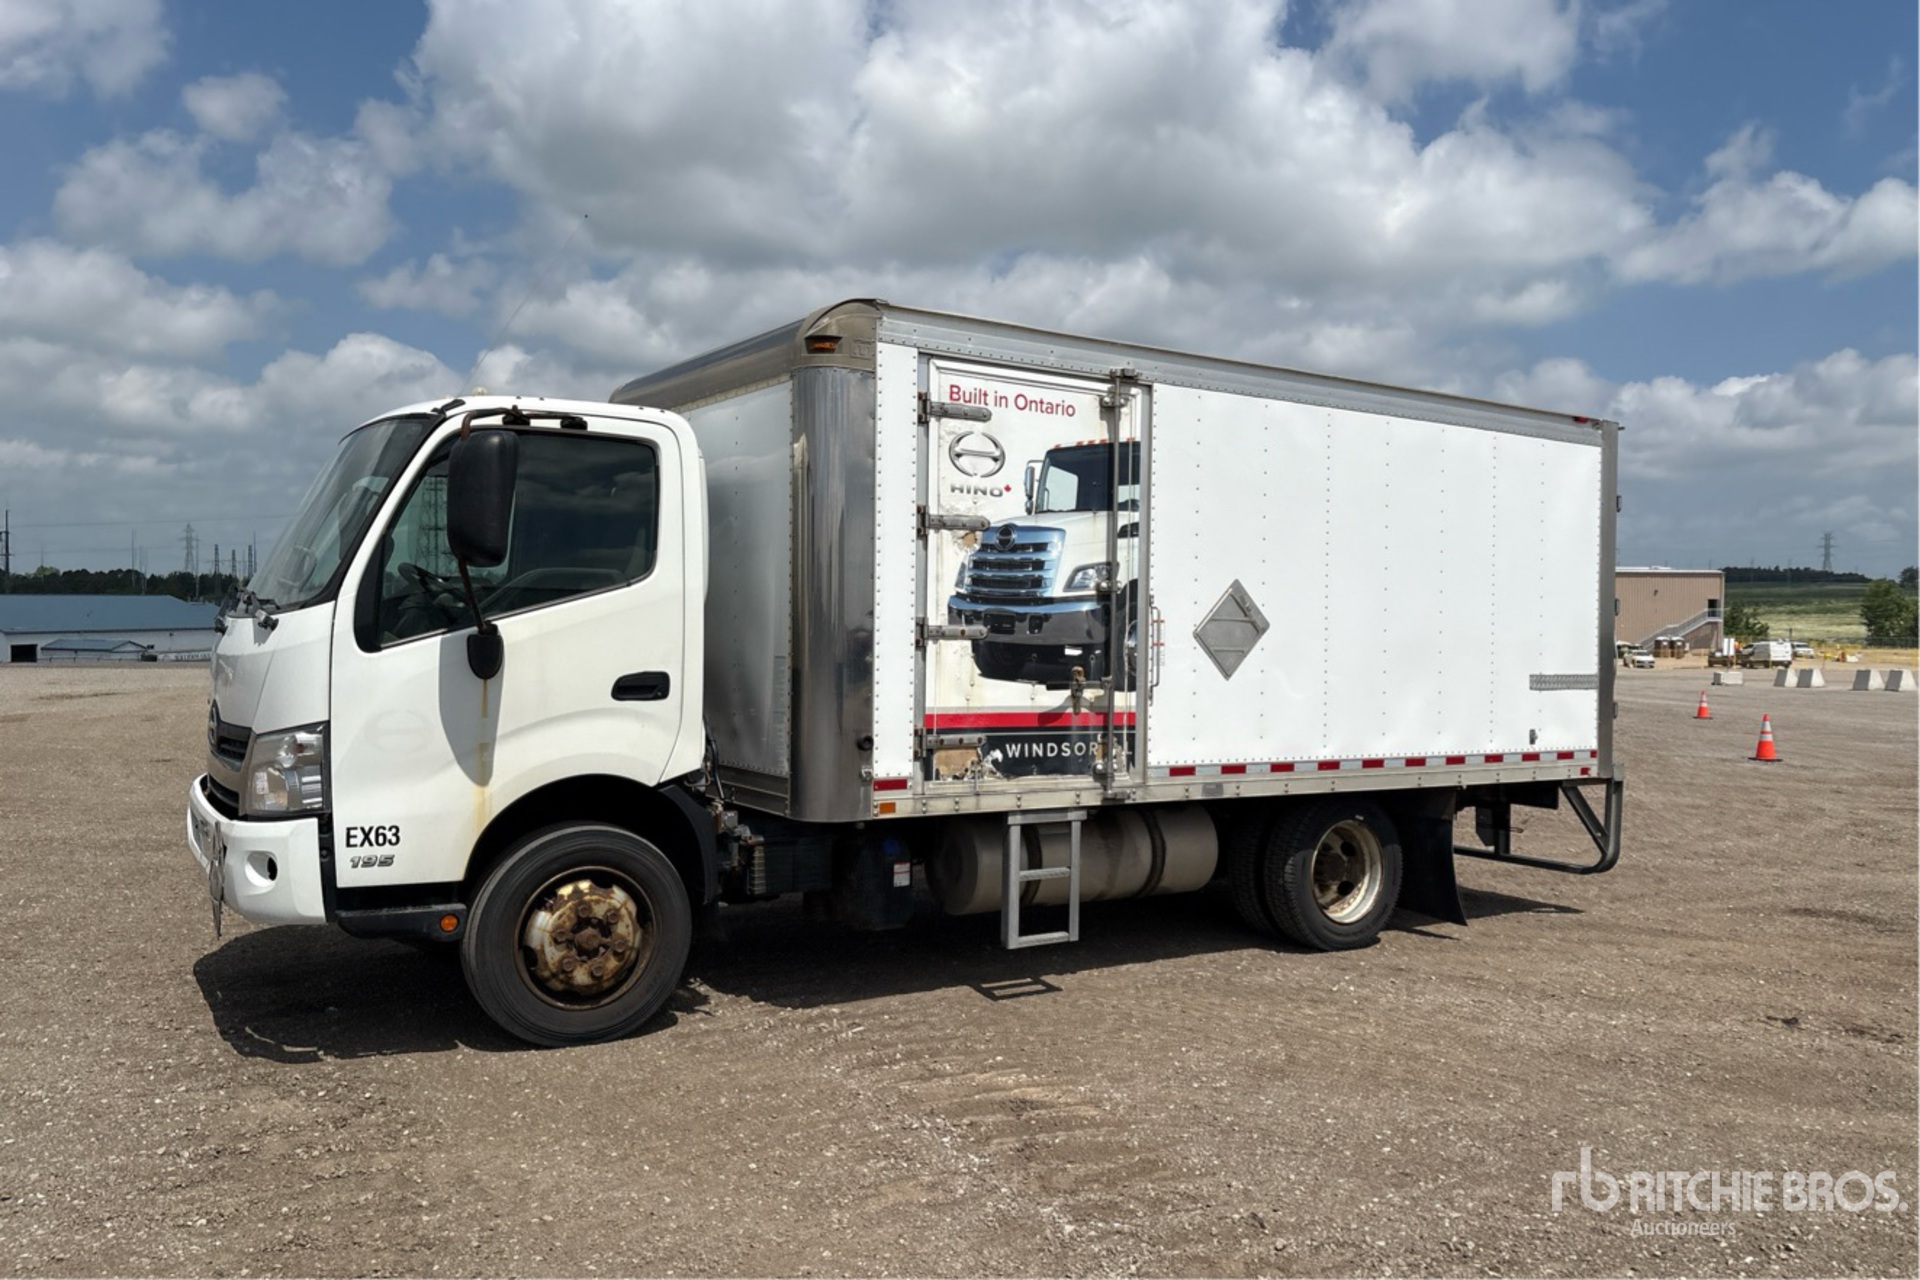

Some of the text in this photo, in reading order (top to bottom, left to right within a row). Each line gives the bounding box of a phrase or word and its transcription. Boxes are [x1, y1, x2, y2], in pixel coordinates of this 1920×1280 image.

[949, 384, 1076, 417] Built in Ontario
[950, 483, 1004, 498] HINO
[1005, 742, 1099, 758] WINDSOR
[345, 825, 401, 848] EX63
[350, 854, 395, 869] 195
